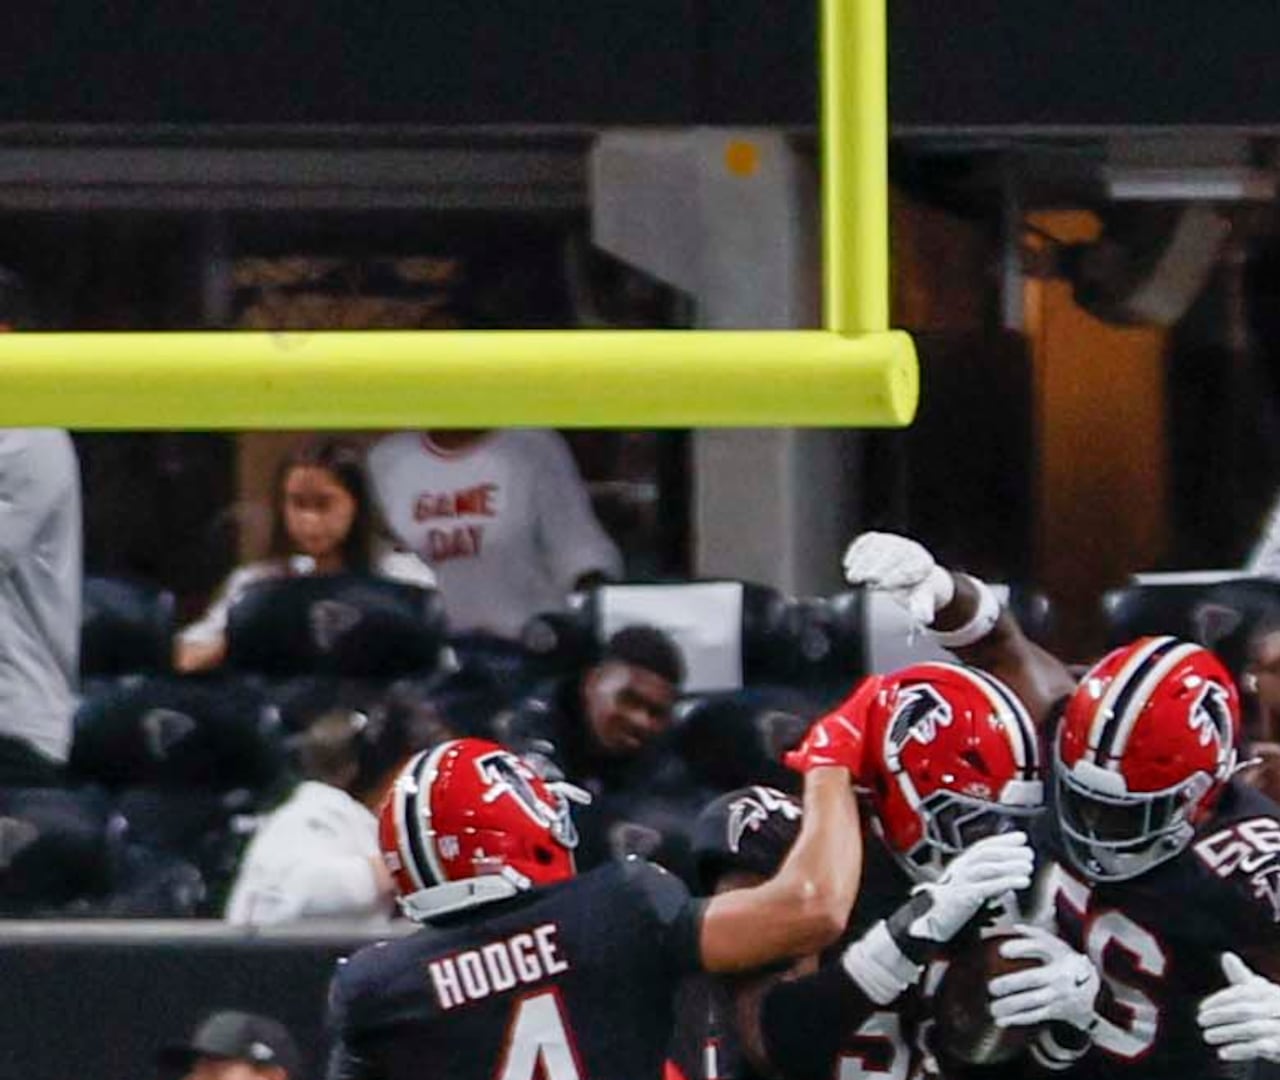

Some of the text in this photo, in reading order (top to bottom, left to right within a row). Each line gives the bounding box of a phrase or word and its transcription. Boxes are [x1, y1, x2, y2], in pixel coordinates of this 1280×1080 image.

[414, 483, 499, 522] GAME
[429, 526, 482, 562] DAY
[429, 923, 569, 1010] HODGE
